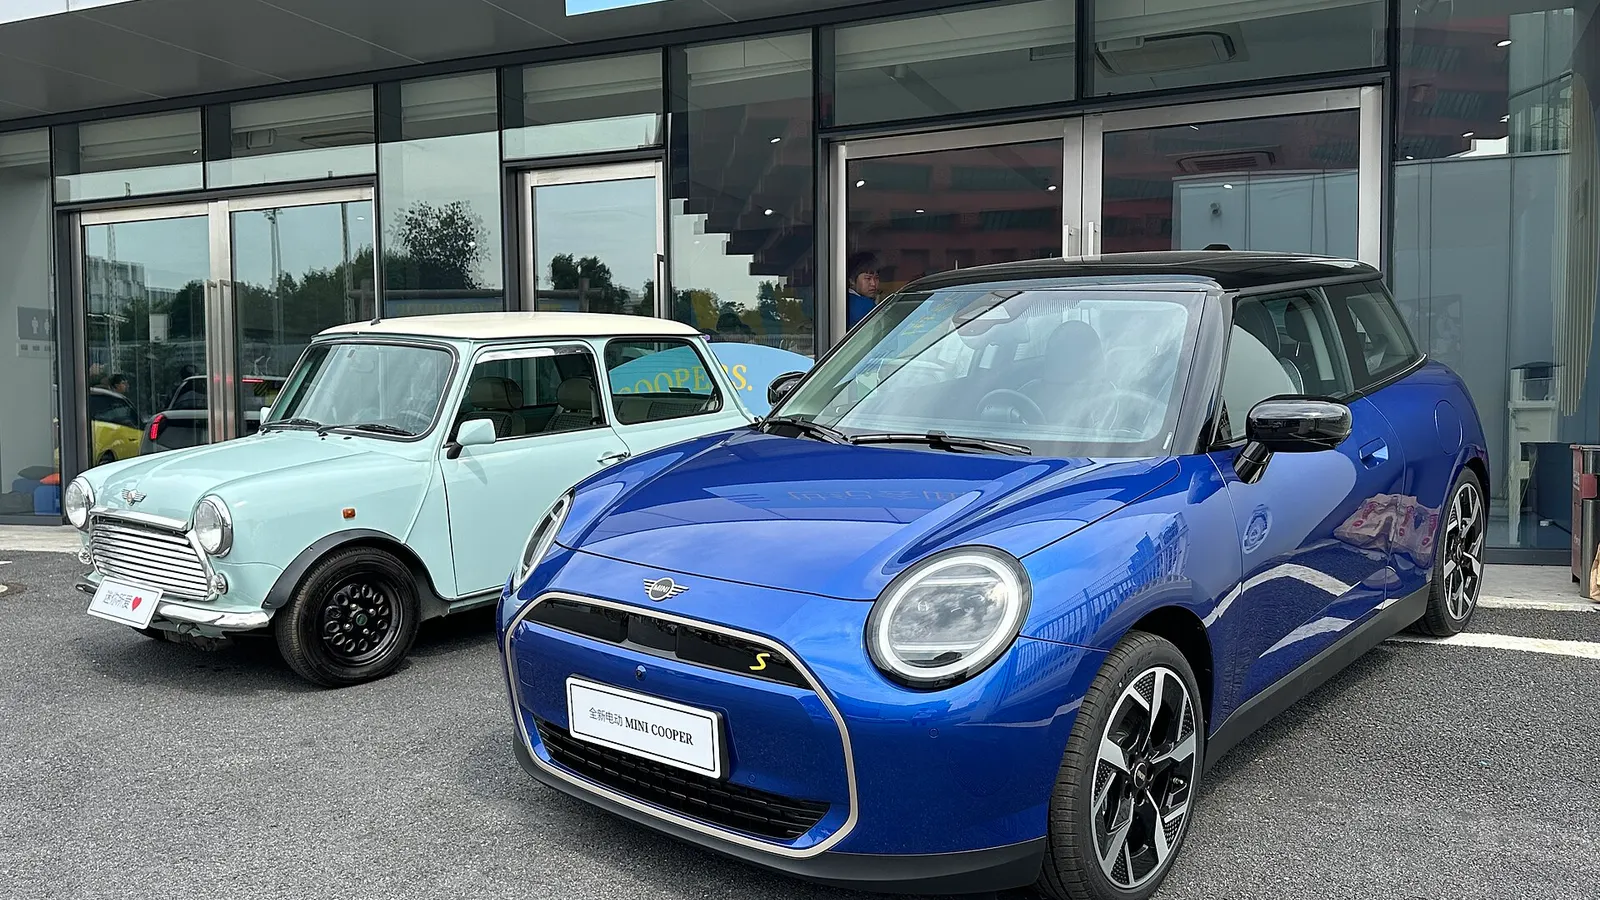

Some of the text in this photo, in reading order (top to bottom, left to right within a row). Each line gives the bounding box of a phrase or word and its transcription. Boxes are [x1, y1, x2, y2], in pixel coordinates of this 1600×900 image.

[618, 364, 753, 393] OOPES.
[652, 584, 671, 593] MINI
[749, 653, 770, 670] S
[589, 707, 694, 746] 全新电动 MINI COOPER
